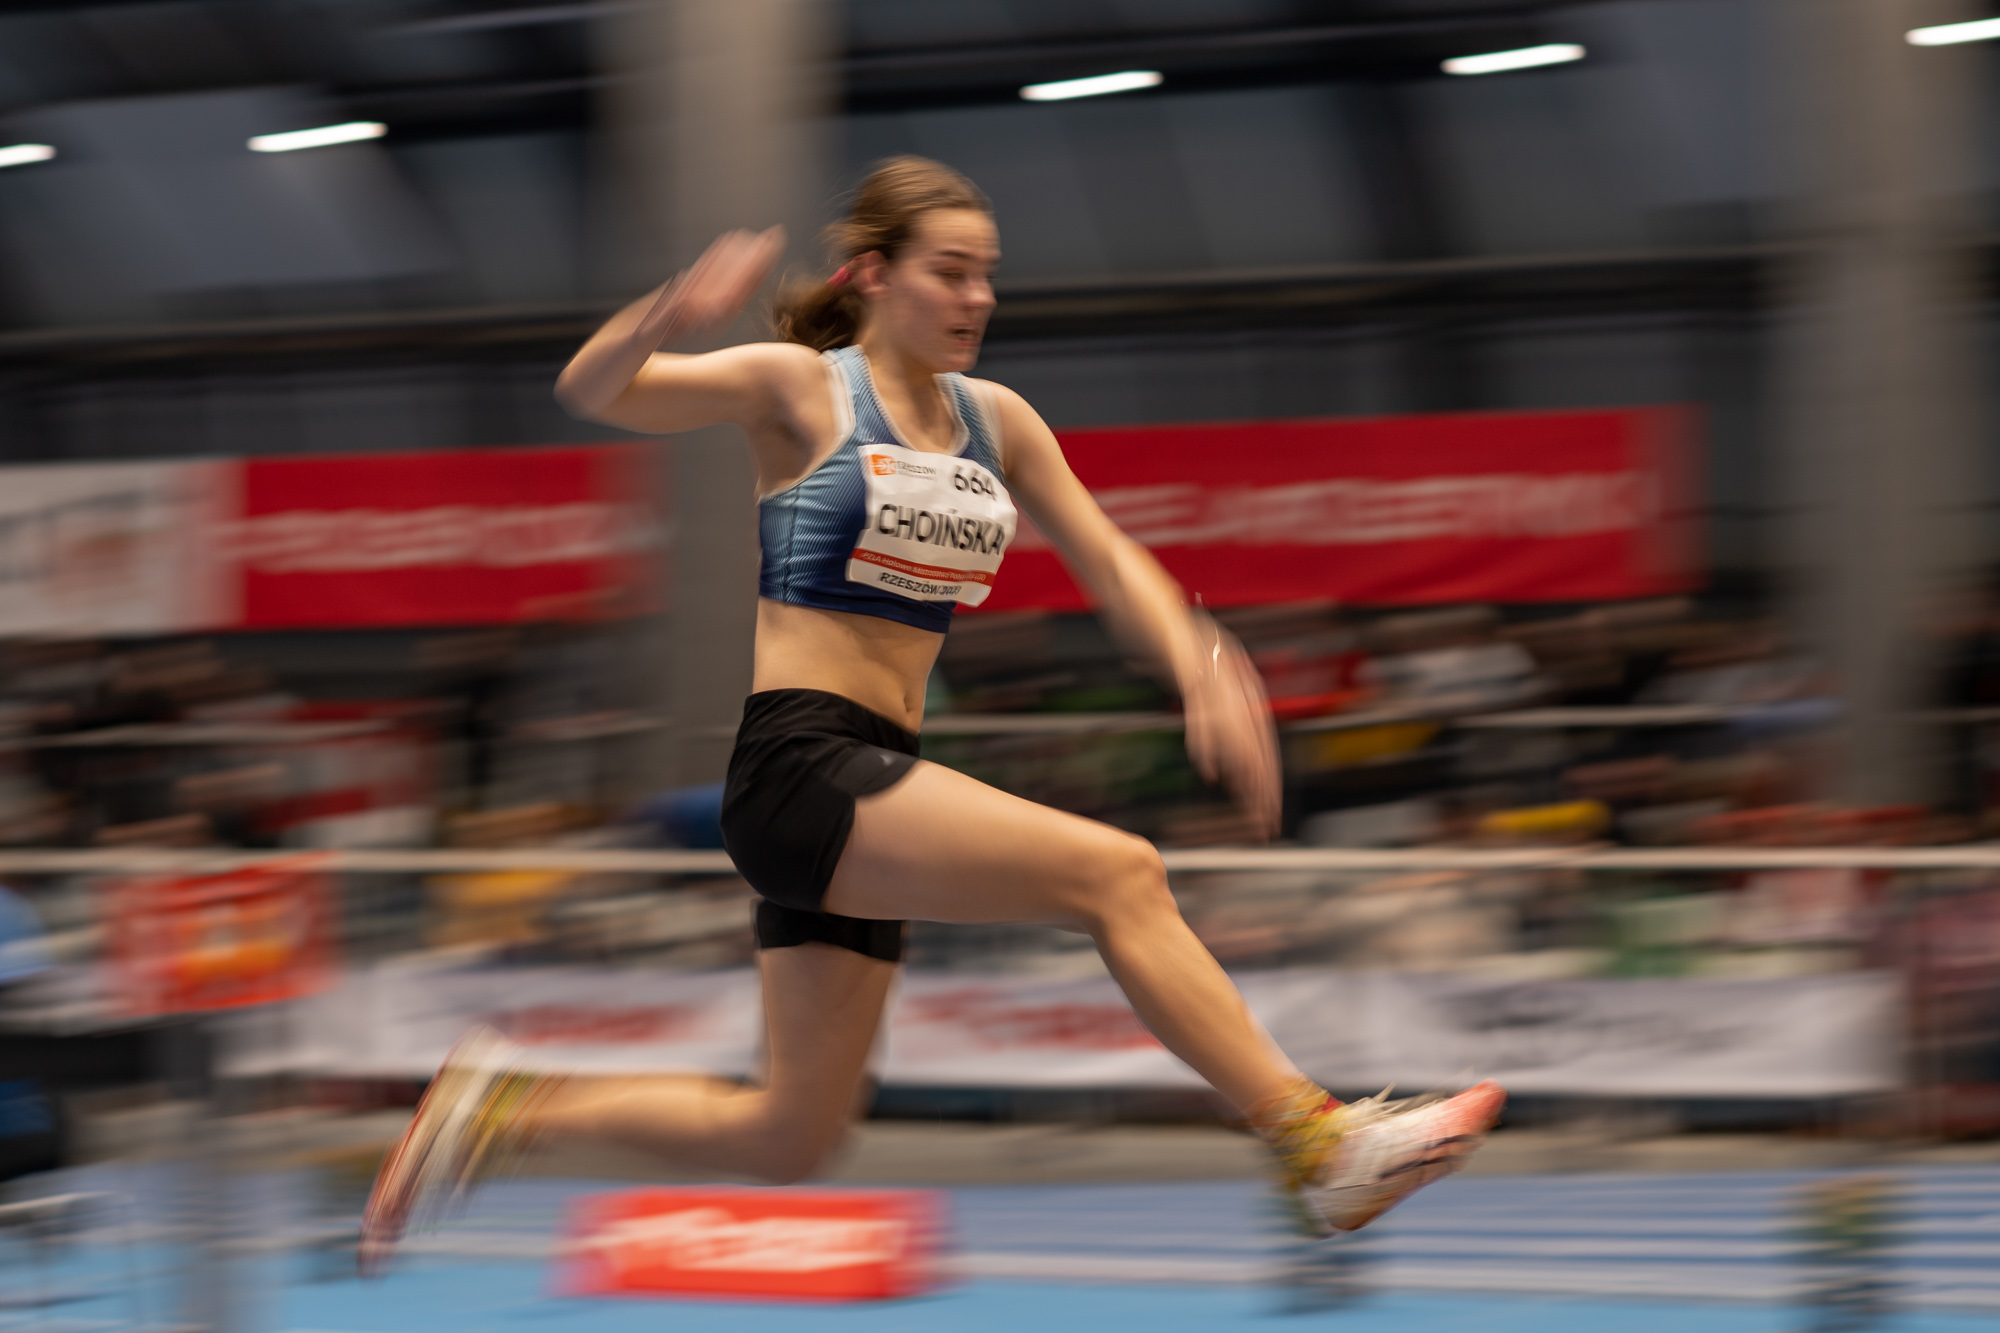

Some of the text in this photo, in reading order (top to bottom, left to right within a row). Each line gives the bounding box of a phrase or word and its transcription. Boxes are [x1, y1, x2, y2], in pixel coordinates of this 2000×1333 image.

[953, 465, 997, 501] 664
[879, 503, 1005, 555] CHOIŃSKA
[880, 572, 940, 595] RZESZÓW
